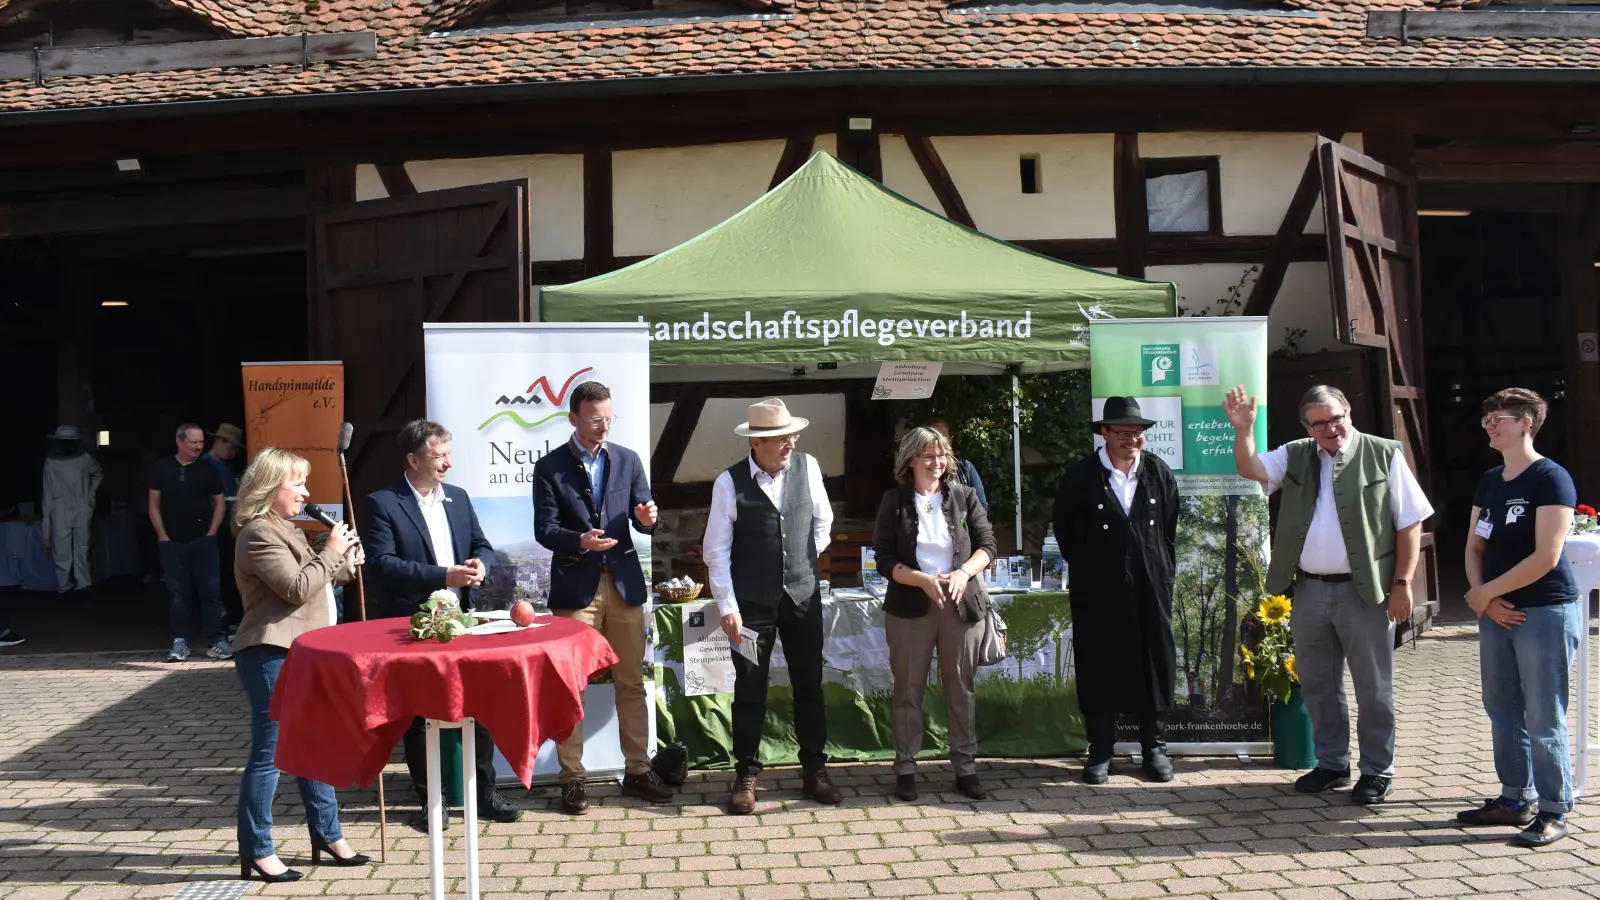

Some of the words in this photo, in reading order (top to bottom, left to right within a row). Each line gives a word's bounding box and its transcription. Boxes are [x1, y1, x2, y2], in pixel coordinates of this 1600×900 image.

[249, 377, 336, 396] Handspinngilde
[313, 397, 335, 409] e.V.
[1150, 420, 1175, 429] TUR
[1145, 433, 1175, 442] CHTE
[1195, 432, 1236, 445] begehe
[1202, 444, 1234, 457] erfah
[489, 472, 508, 484] an
[514, 467, 534, 484] de
[697, 635, 728, 643] Abholun
[690, 655, 732, 664] Stempelakti
